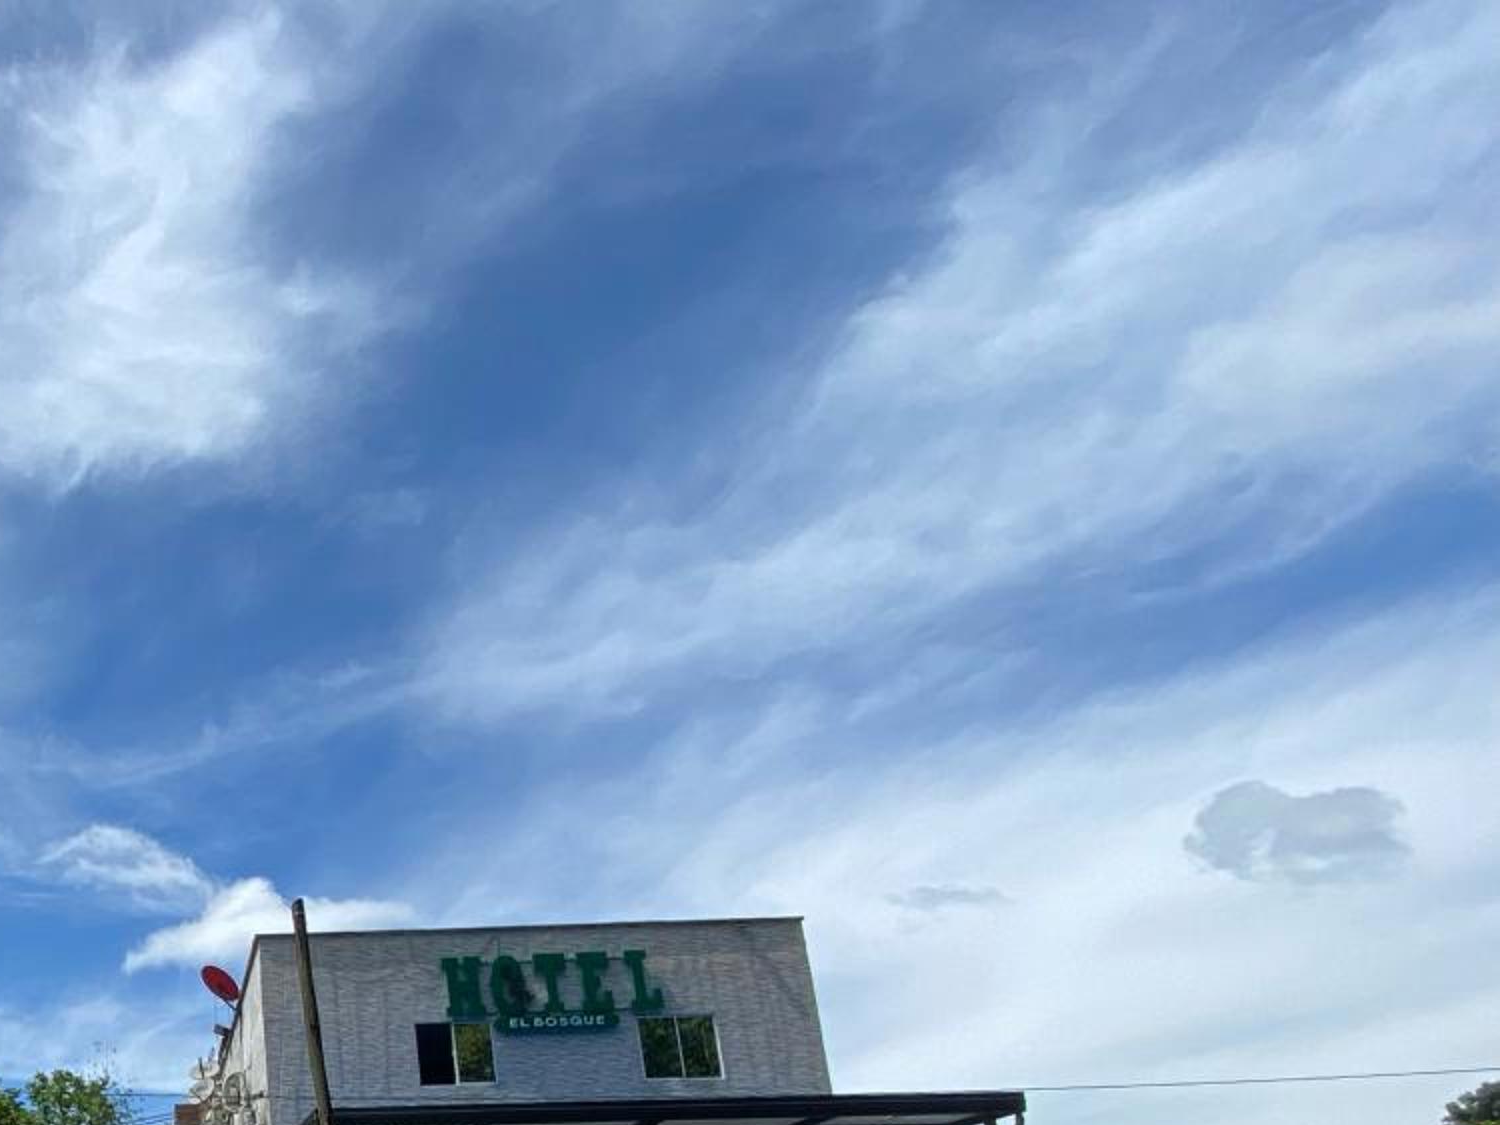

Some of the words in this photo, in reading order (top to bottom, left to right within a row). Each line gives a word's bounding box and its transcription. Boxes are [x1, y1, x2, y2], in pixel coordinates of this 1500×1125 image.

[441, 950, 665, 1017] HOTEL
[509, 1017, 530, 1029] EL
[533, 1015, 605, 1028] BOSQUE
